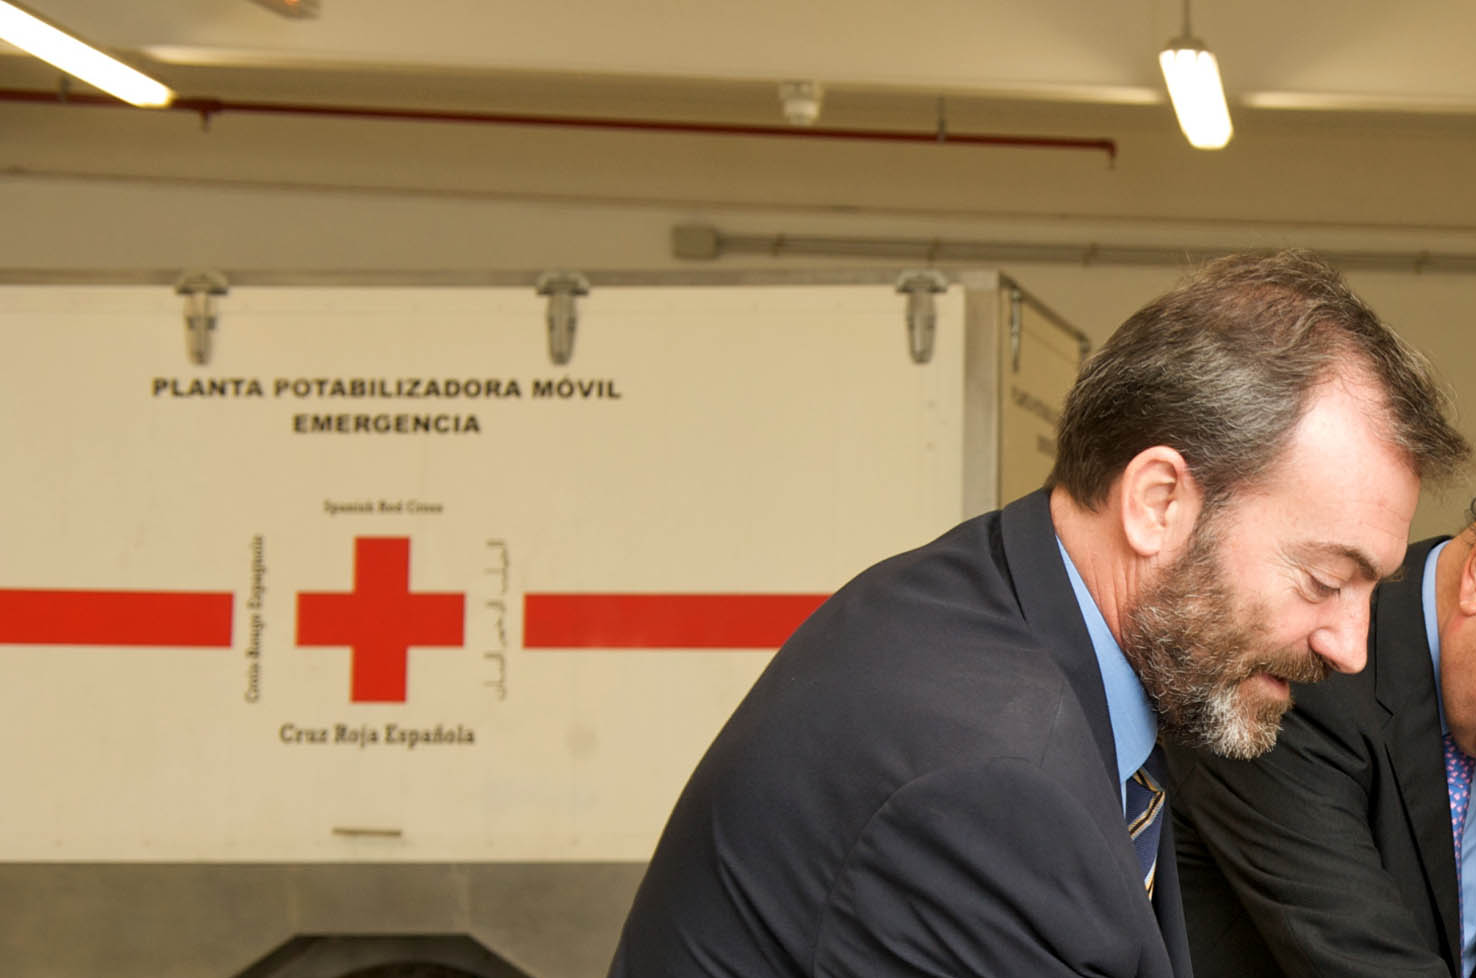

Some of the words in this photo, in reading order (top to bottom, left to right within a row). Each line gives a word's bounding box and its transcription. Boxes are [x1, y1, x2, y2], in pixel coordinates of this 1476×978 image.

[152, 378, 264, 398] PLANTA
[274, 378, 521, 399] POTABILIZADORA
[531, 375, 621, 399] MÓVIL
[293, 414, 481, 434] EMERGENCIA
[279, 723, 327, 744] Cruz
[334, 723, 378, 749] Roja
[385, 723, 475, 749] Española
